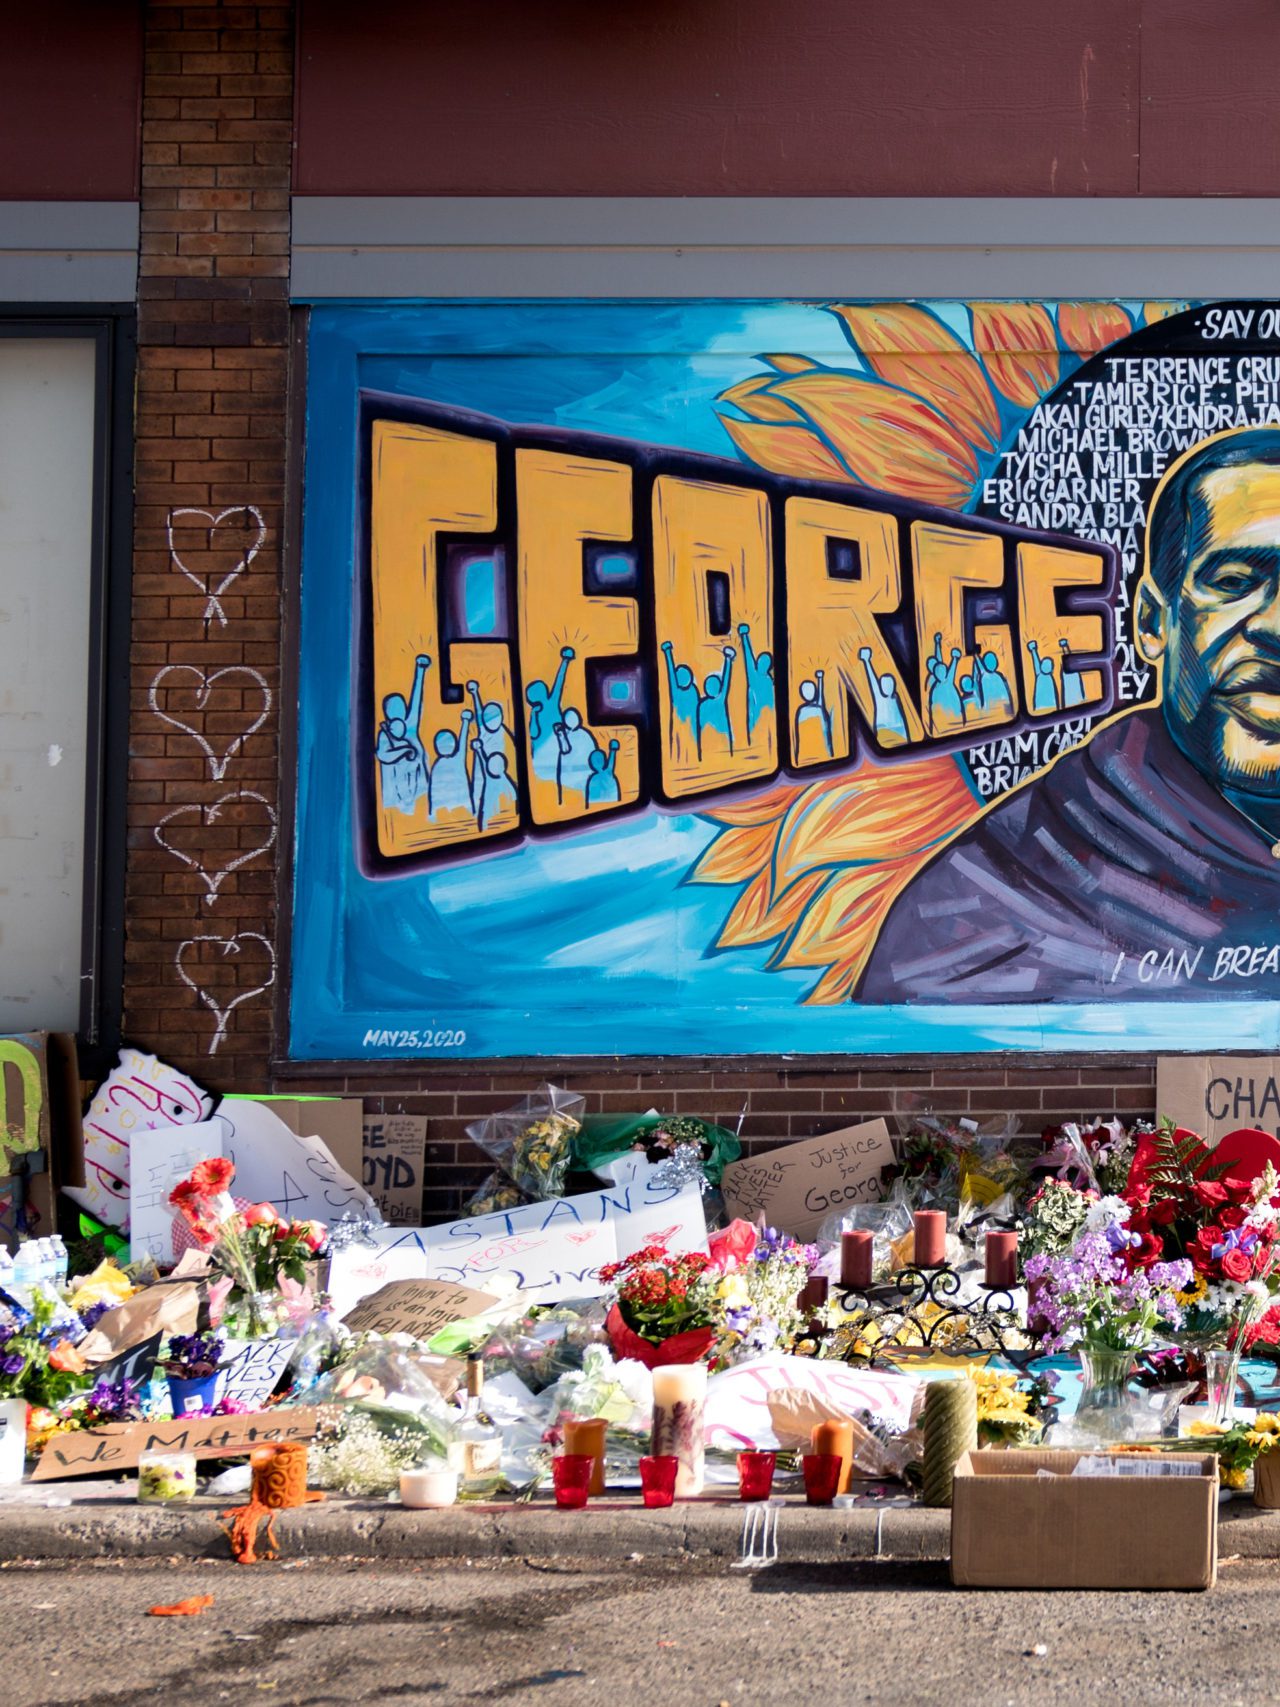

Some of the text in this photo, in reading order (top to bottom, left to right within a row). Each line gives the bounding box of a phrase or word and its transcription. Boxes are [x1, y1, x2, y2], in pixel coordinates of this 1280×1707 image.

[1202, 309, 1255, 339] SAY
[1104, 357, 1231, 385] TERRENCE
[1074, 382, 1150, 406] TAMIR
[1152, 382, 1212, 407] RICE
[1029, 404, 1079, 430] AKAI
[1085, 404, 1157, 431] GURLEY
[1159, 404, 1248, 430] KENDRA
[1018, 429, 1121, 454] MICHAEL
[1000, 452, 1082, 481] TYISHA
[983, 479, 1141, 504] ERIC GARNER
[1000, 502, 1098, 530] SANDRA
[369, 417, 1108, 858] GEORGE
[1110, 951, 1125, 983] I
[1137, 946, 1204, 983] CAN
[809, 1136, 883, 1169] Justice
[838, 1160, 862, 1180] for
[736, 1168, 768, 1207] LIVES
[744, 1161, 797, 1221] MATTER
[804, 1175, 883, 1213] Georg
[375, 1182, 681, 1261] ASIANS
[53, 1440, 125, 1466] We
